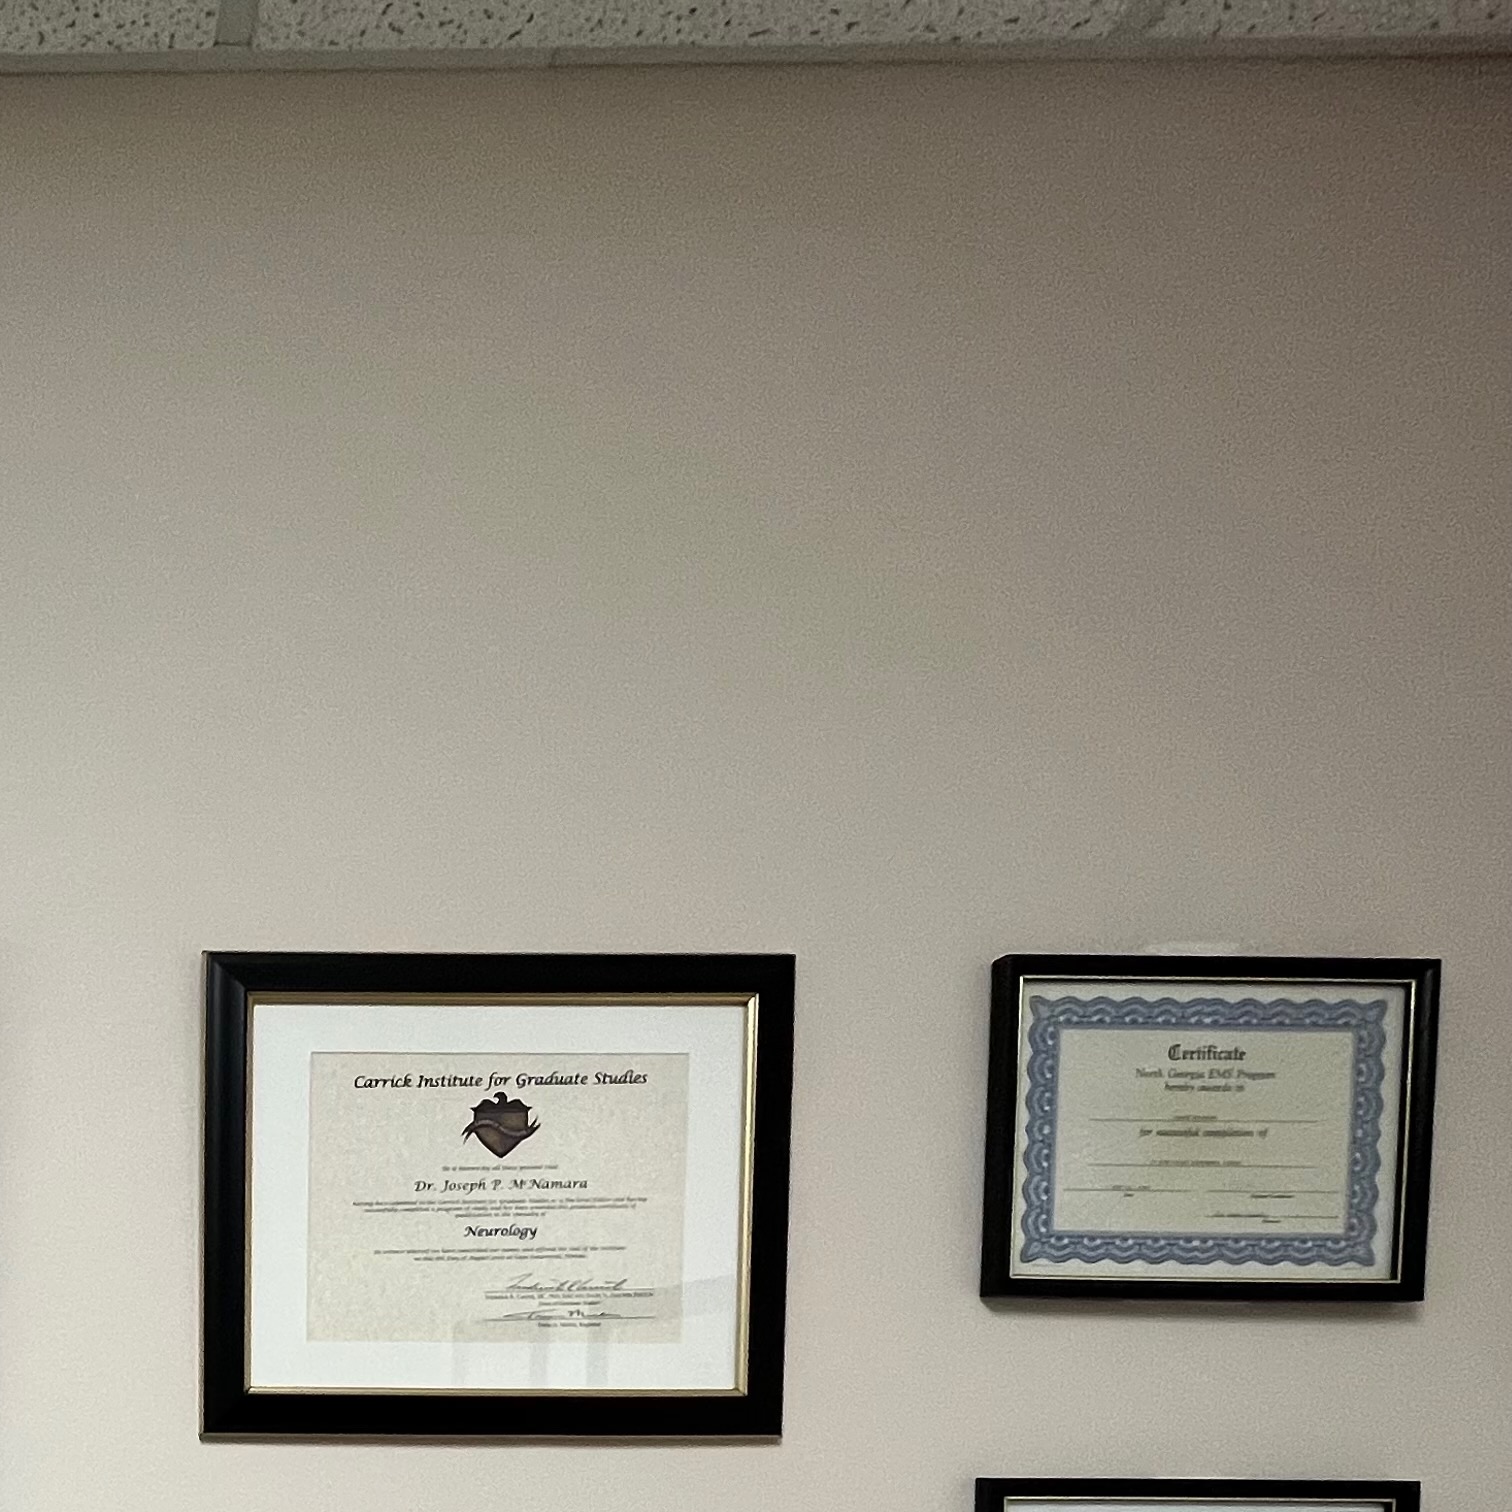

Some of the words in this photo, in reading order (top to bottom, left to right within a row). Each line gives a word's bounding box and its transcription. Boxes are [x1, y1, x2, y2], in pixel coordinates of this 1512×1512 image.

[1168, 1044, 1246, 1061] Certificate
[355, 1074, 412, 1088] Carrick
[417, 1075, 483, 1088] Institute
[485, 1072, 511, 1091] for
[516, 1071, 588, 1089] Graduate
[593, 1070, 647, 1085] Studies
[415, 1181, 434, 1191] Dr.
[440, 1178, 486, 1195] Joseph
[491, 1179, 503, 1190] P.
[464, 1224, 537, 1240] Neurology
